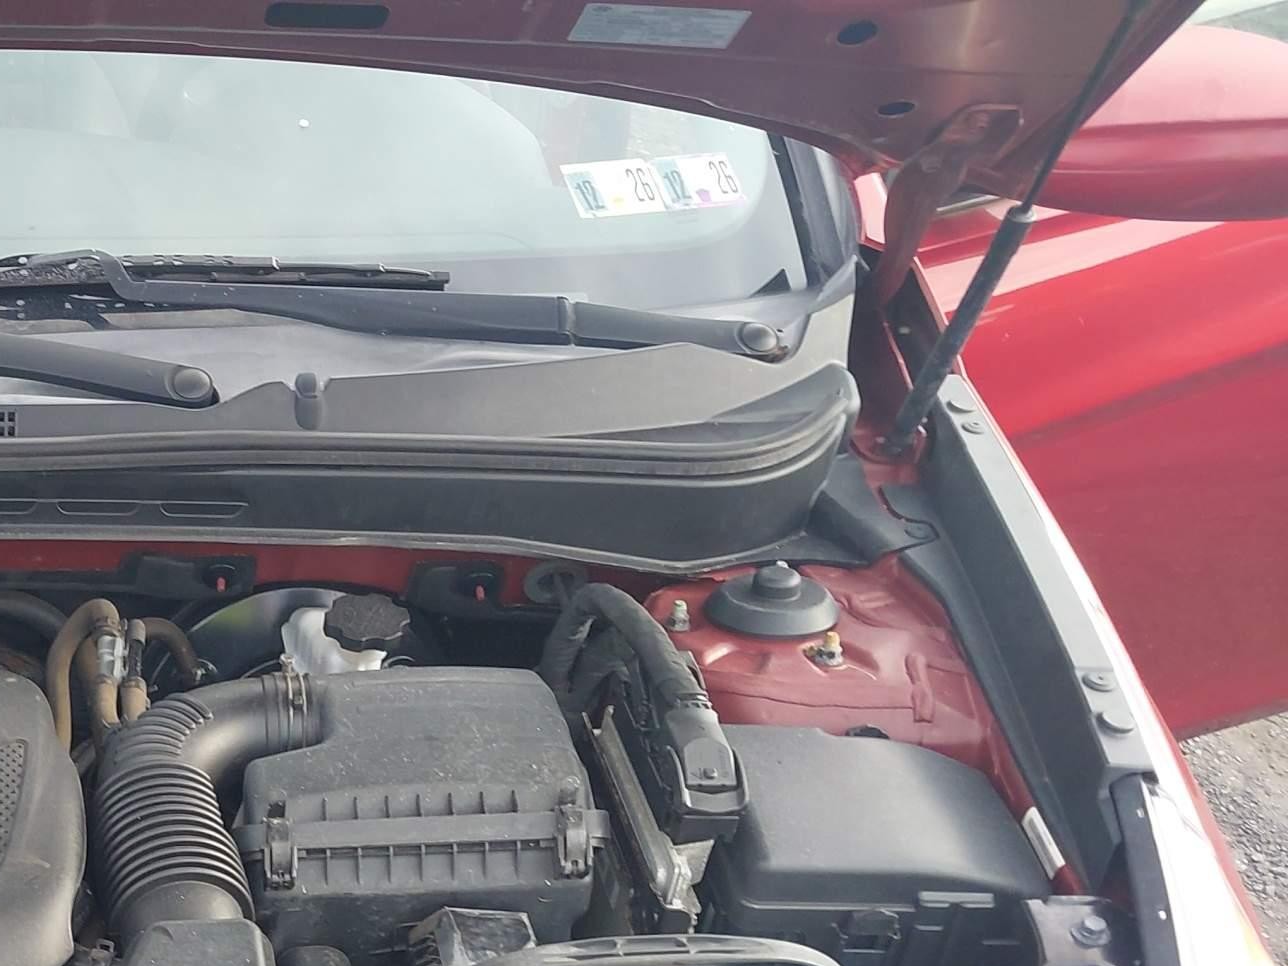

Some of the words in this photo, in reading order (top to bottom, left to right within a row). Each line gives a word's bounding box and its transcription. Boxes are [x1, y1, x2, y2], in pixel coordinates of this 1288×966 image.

[575, 179, 606, 212] 12
[624, 167, 656, 203] 26
[663, 169, 692, 204] 12
[707, 159, 739, 195] 26
